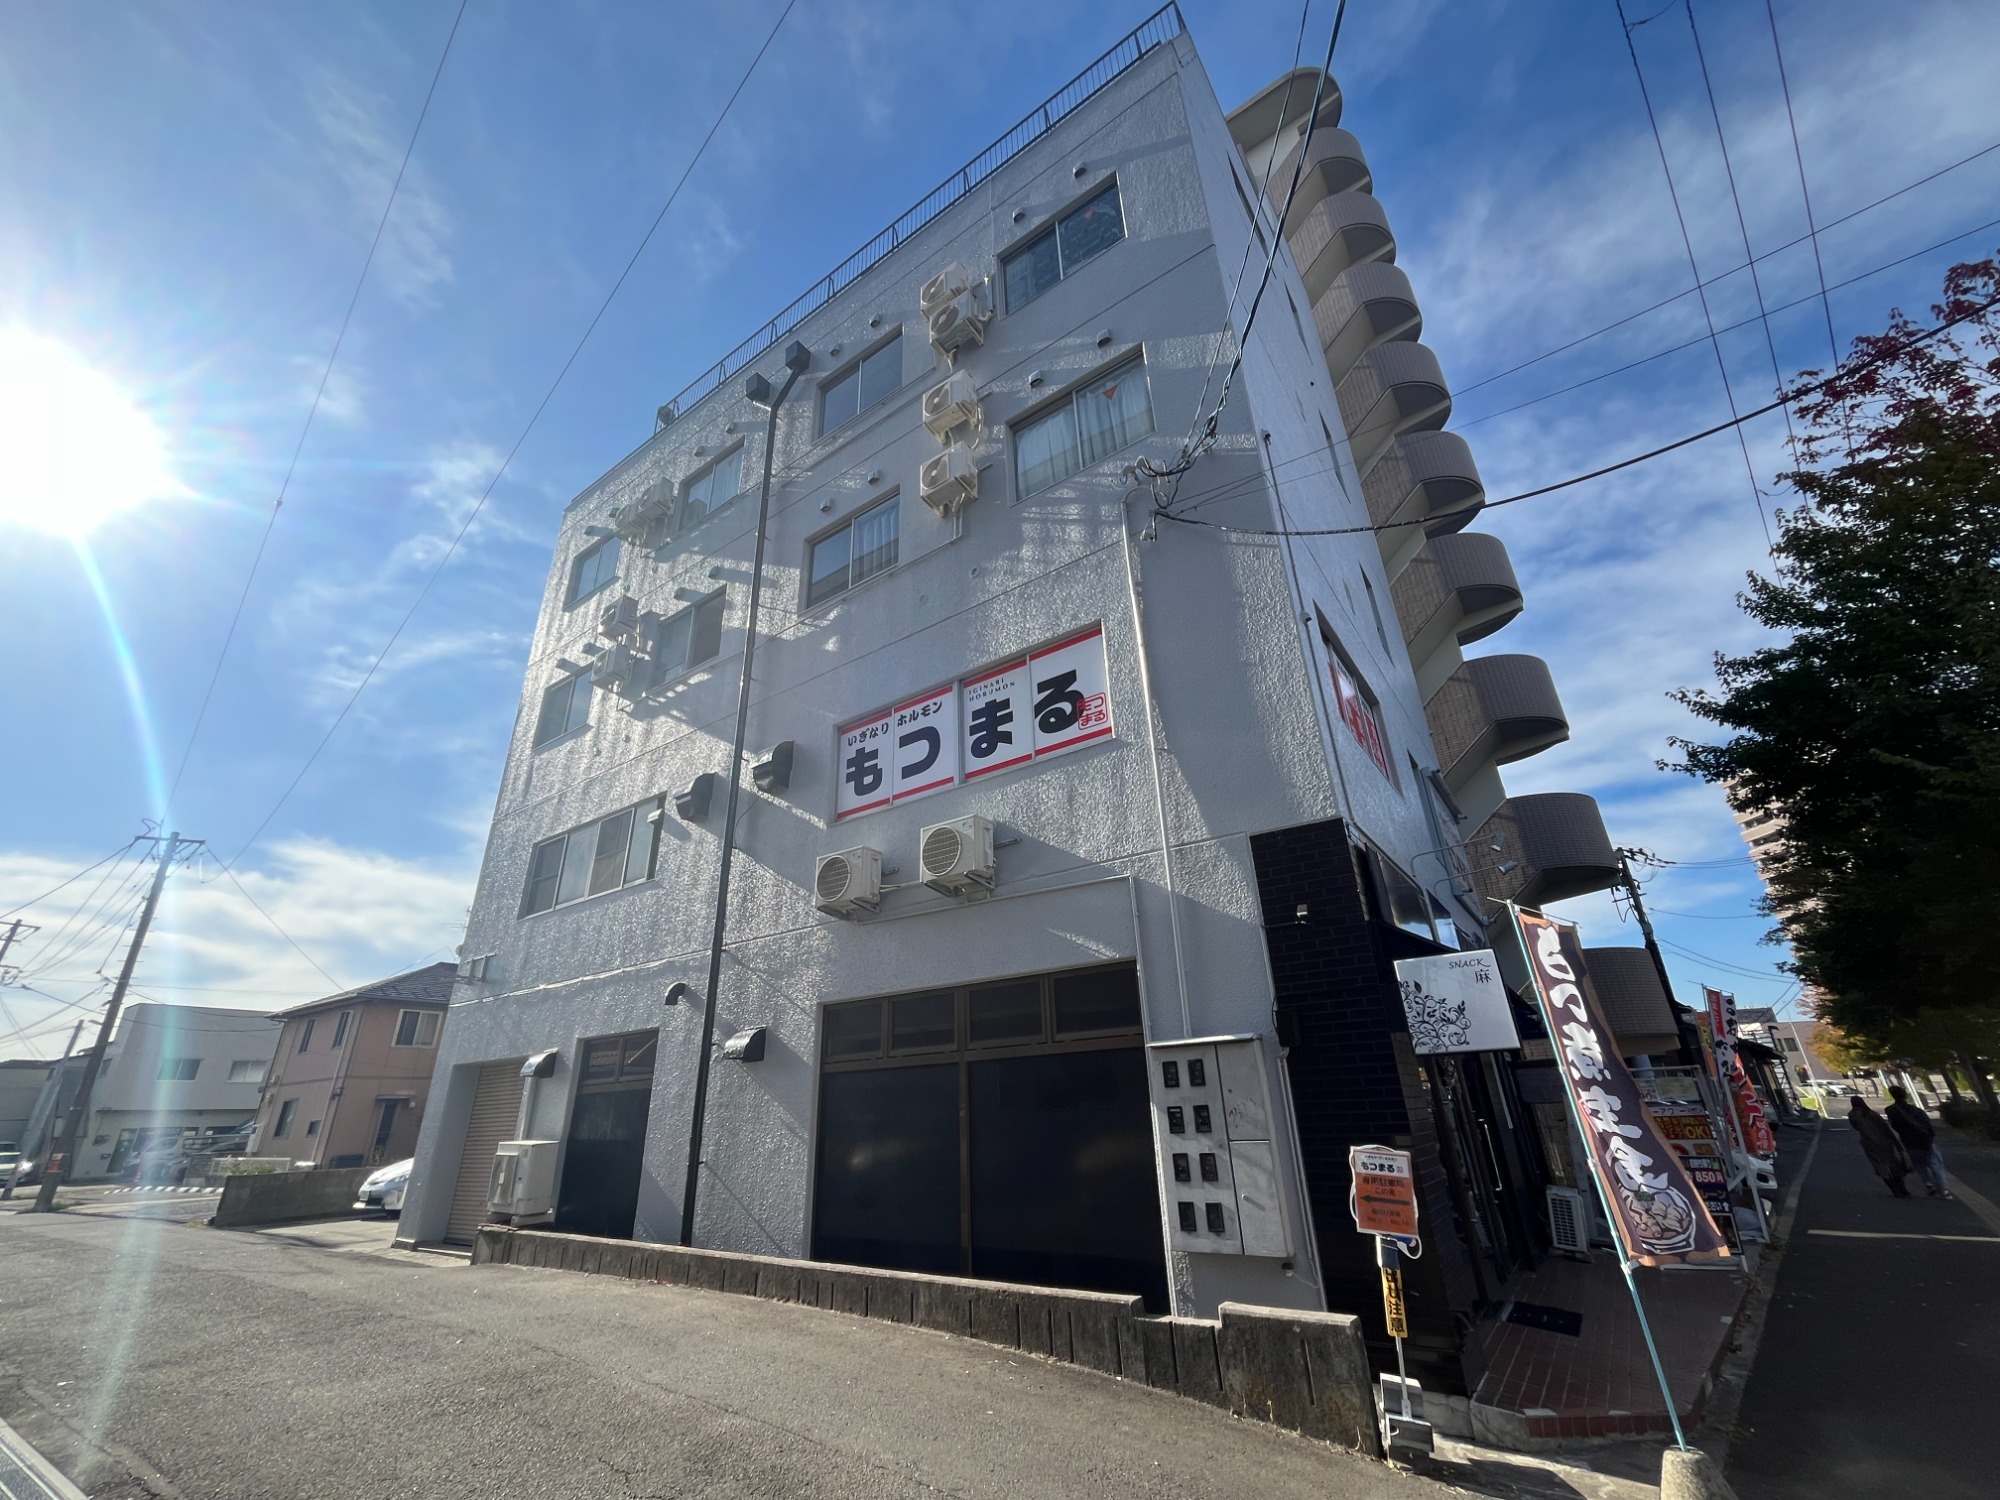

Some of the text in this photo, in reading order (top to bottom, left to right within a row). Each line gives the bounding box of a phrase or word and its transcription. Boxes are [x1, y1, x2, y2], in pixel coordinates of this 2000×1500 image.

[969, 678, 1005, 695] IGINARI
[969, 681, 1016, 702] HORUMON
[847, 700, 943, 746] いぎなり ホルモン
[1080, 709, 1106, 727] まる
[846, 669, 1085, 797] もつまる
[1448, 958, 1491, 970] SNACK
[1475, 969, 1492, 984] 麻
[1686, 1124, 1711, 1139] OK!
[1361, 1161, 1395, 1173] もつまる
[1695, 1170, 1724, 1183] 850円
